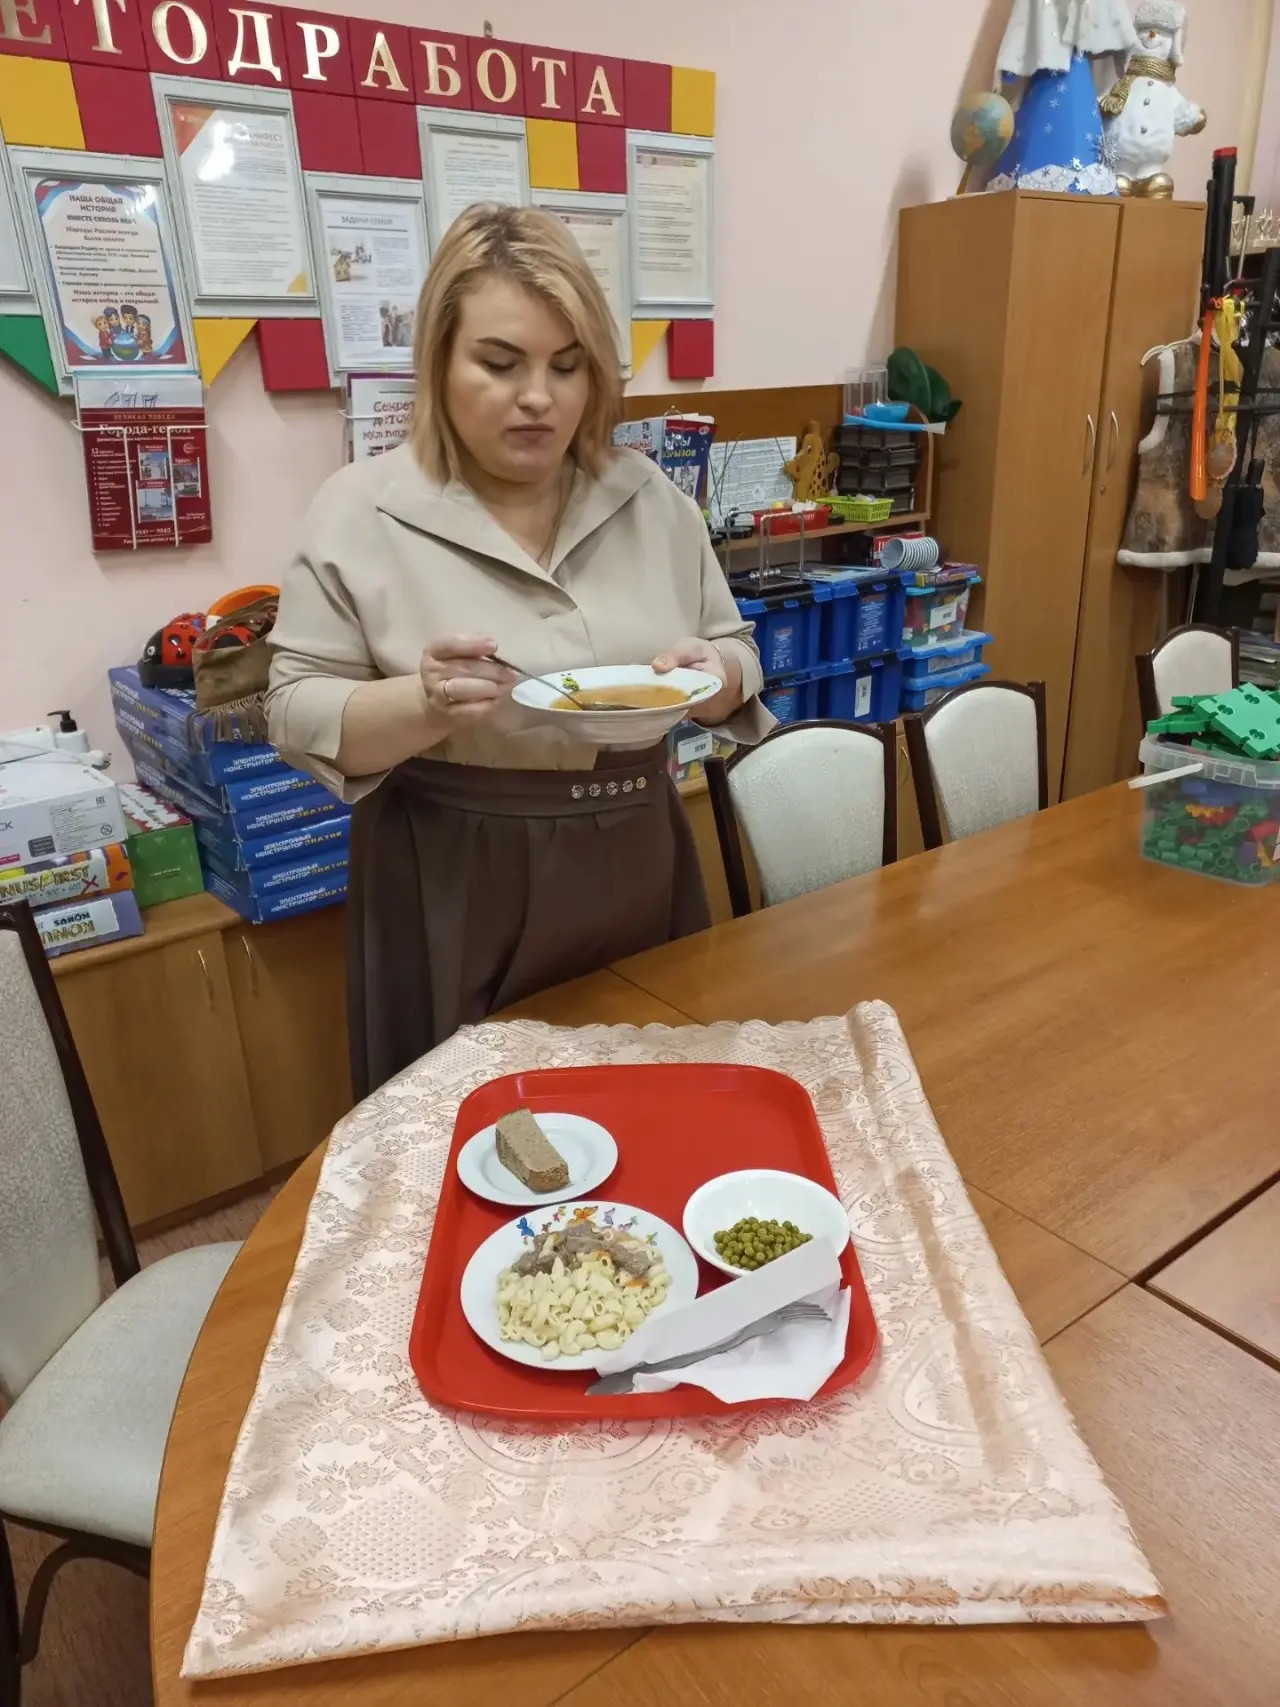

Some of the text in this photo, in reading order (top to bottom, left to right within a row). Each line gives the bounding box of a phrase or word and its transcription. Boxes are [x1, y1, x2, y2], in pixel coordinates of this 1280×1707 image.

[69, 195, 123, 205] НАША ОБЩАЯ
[80, 204, 116, 213] ИСТОРИЯ
[250, 778, 299, 793] ЭЛЕКТРОННЫЙ
[255, 806, 303, 822] ЭЛЕКТРОННЫЙ
[264, 833, 311, 850] ЭЛЕКТРОННЫЙ
